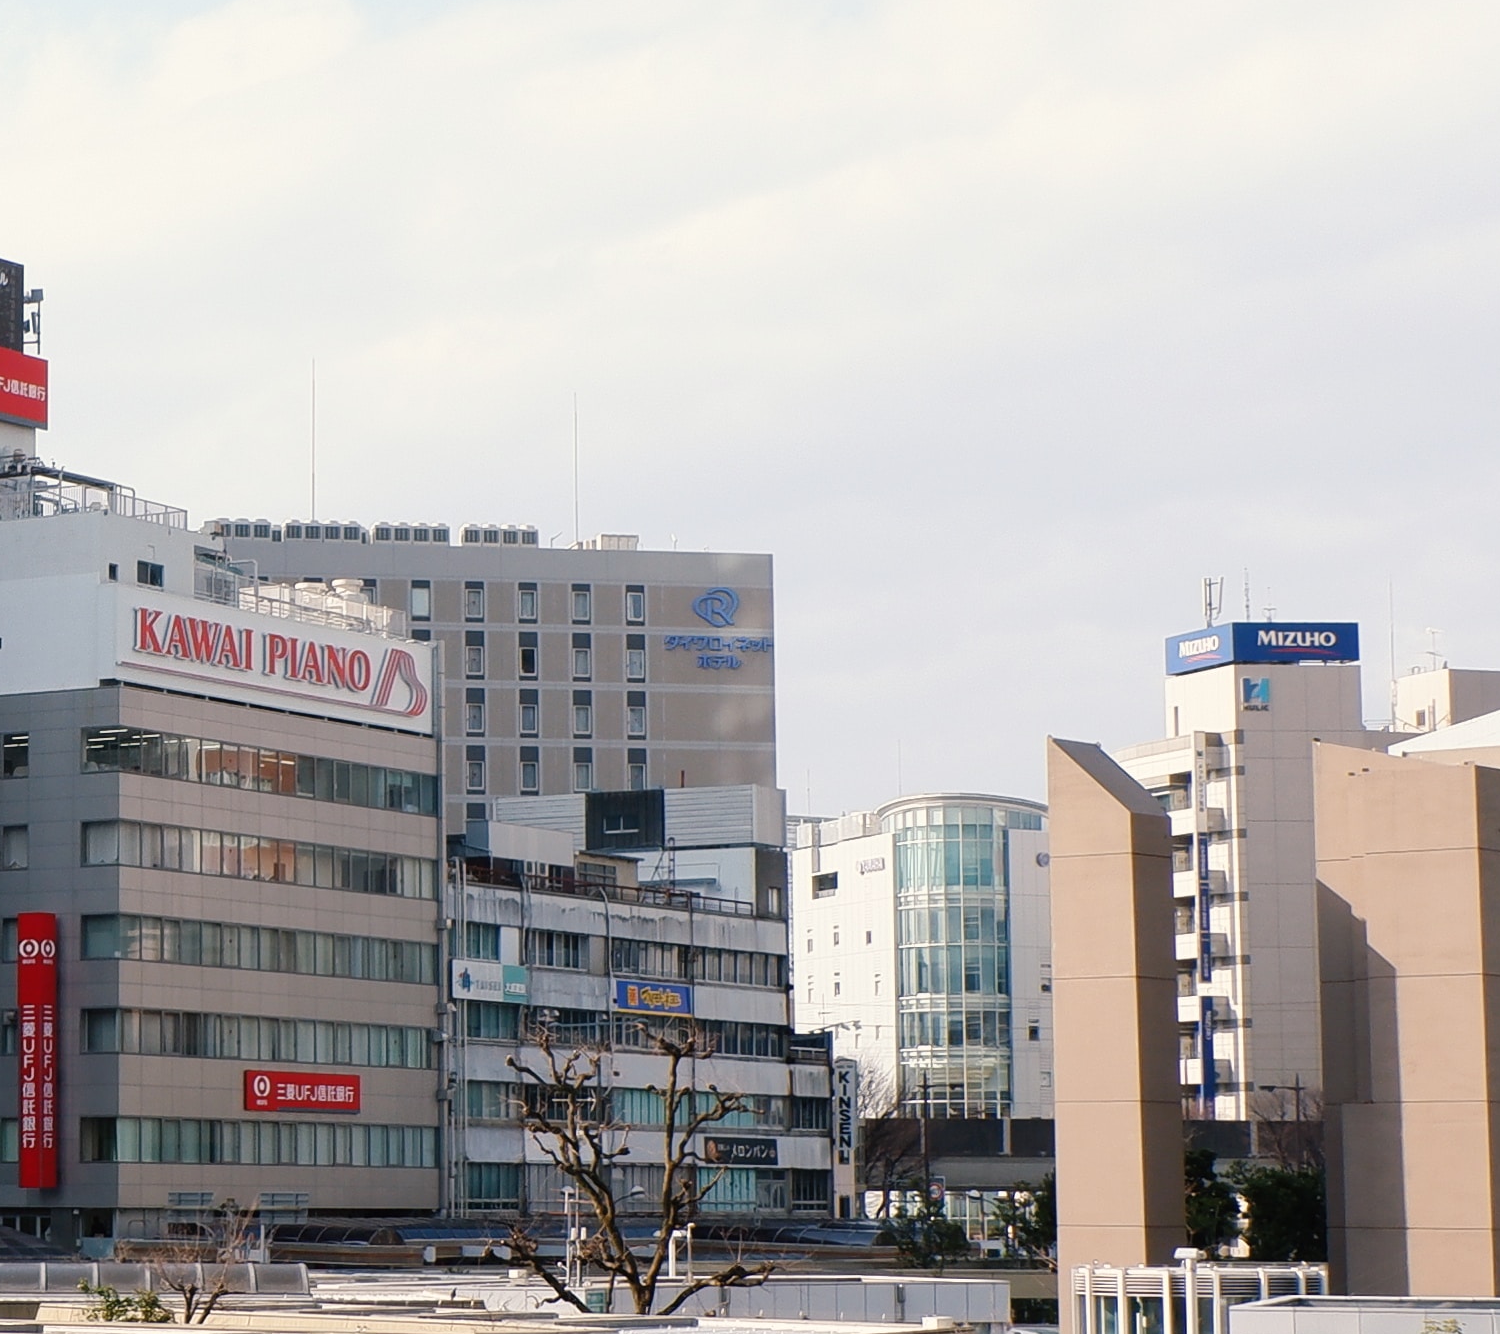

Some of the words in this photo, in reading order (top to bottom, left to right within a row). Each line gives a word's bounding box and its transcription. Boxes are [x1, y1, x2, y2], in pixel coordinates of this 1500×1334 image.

[136, 607, 254, 672] KAWAI
[266, 632, 371, 692] PIANO
[664, 635, 773, 652] ダイワロイネット
[1179, 636, 1219, 658] MIZUHO
[1257, 630, 1337, 648] MIZUHO
[697, 655, 741, 670] ホテル
[22, 1005, 36, 1148] 三菱UFJ信託銀行
[43, 1005, 53, 1148] 三菱UFJ信託銀行
[277, 1083, 355, 1104] 三菱UFJ信託銀行
